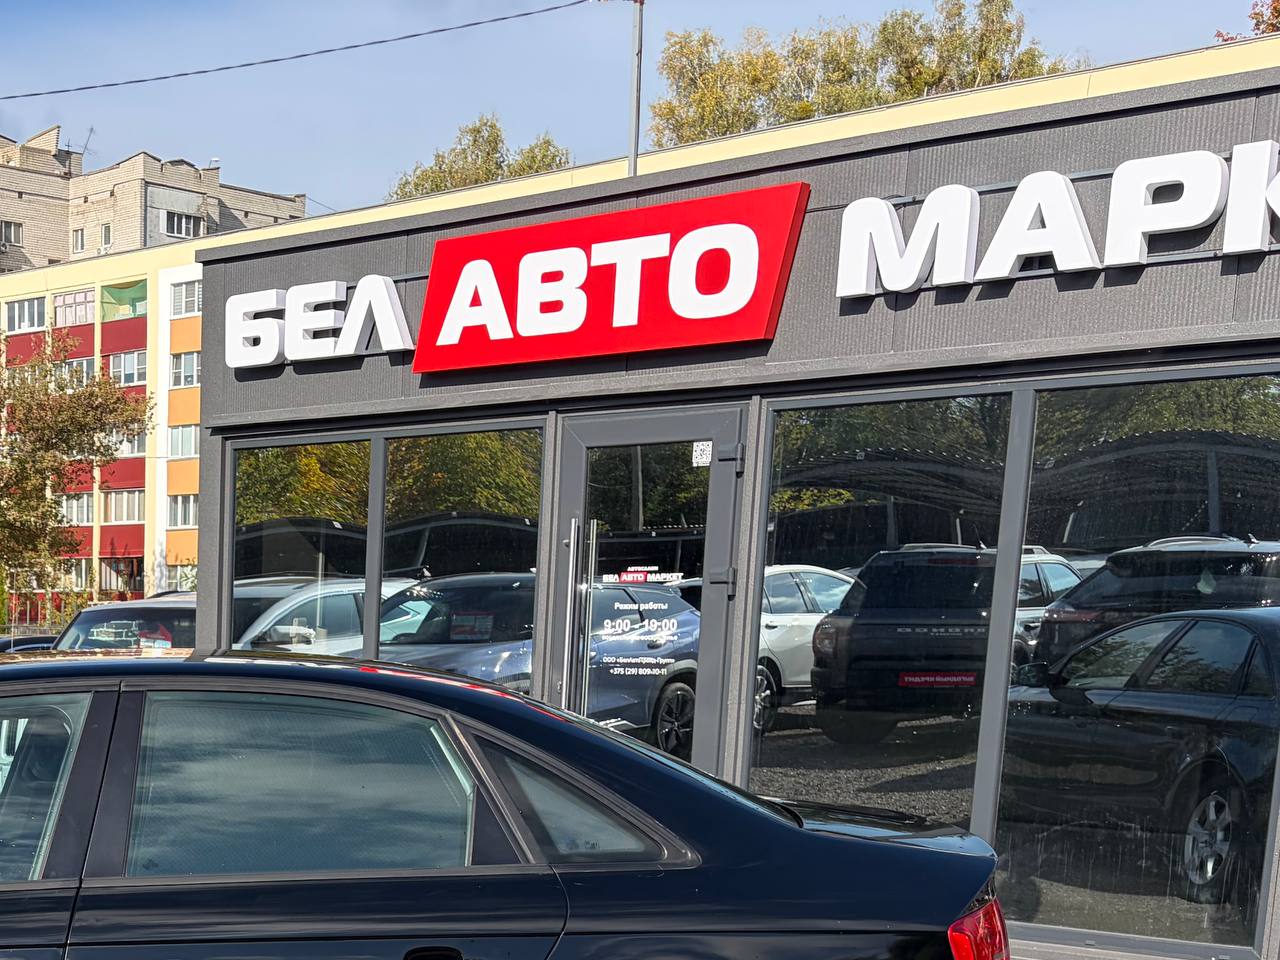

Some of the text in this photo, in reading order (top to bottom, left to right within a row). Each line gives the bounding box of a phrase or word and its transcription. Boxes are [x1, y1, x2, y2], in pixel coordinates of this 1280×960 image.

[225, 274, 417, 368] БЕЛ
[435, 223, 759, 346] АВТО
[621, 573, 645, 581] АВТО
[646, 572, 684, 582] МАРКЕТ
[614, 601, 669, 611] Режим работы
[603, 619, 631, 632] 9:00
[643, 618, 678, 632] 19:00
[602, 656, 617, 664] ООО
[609, 667, 625, 676] +375
[625, 667, 638, 676] (29)
